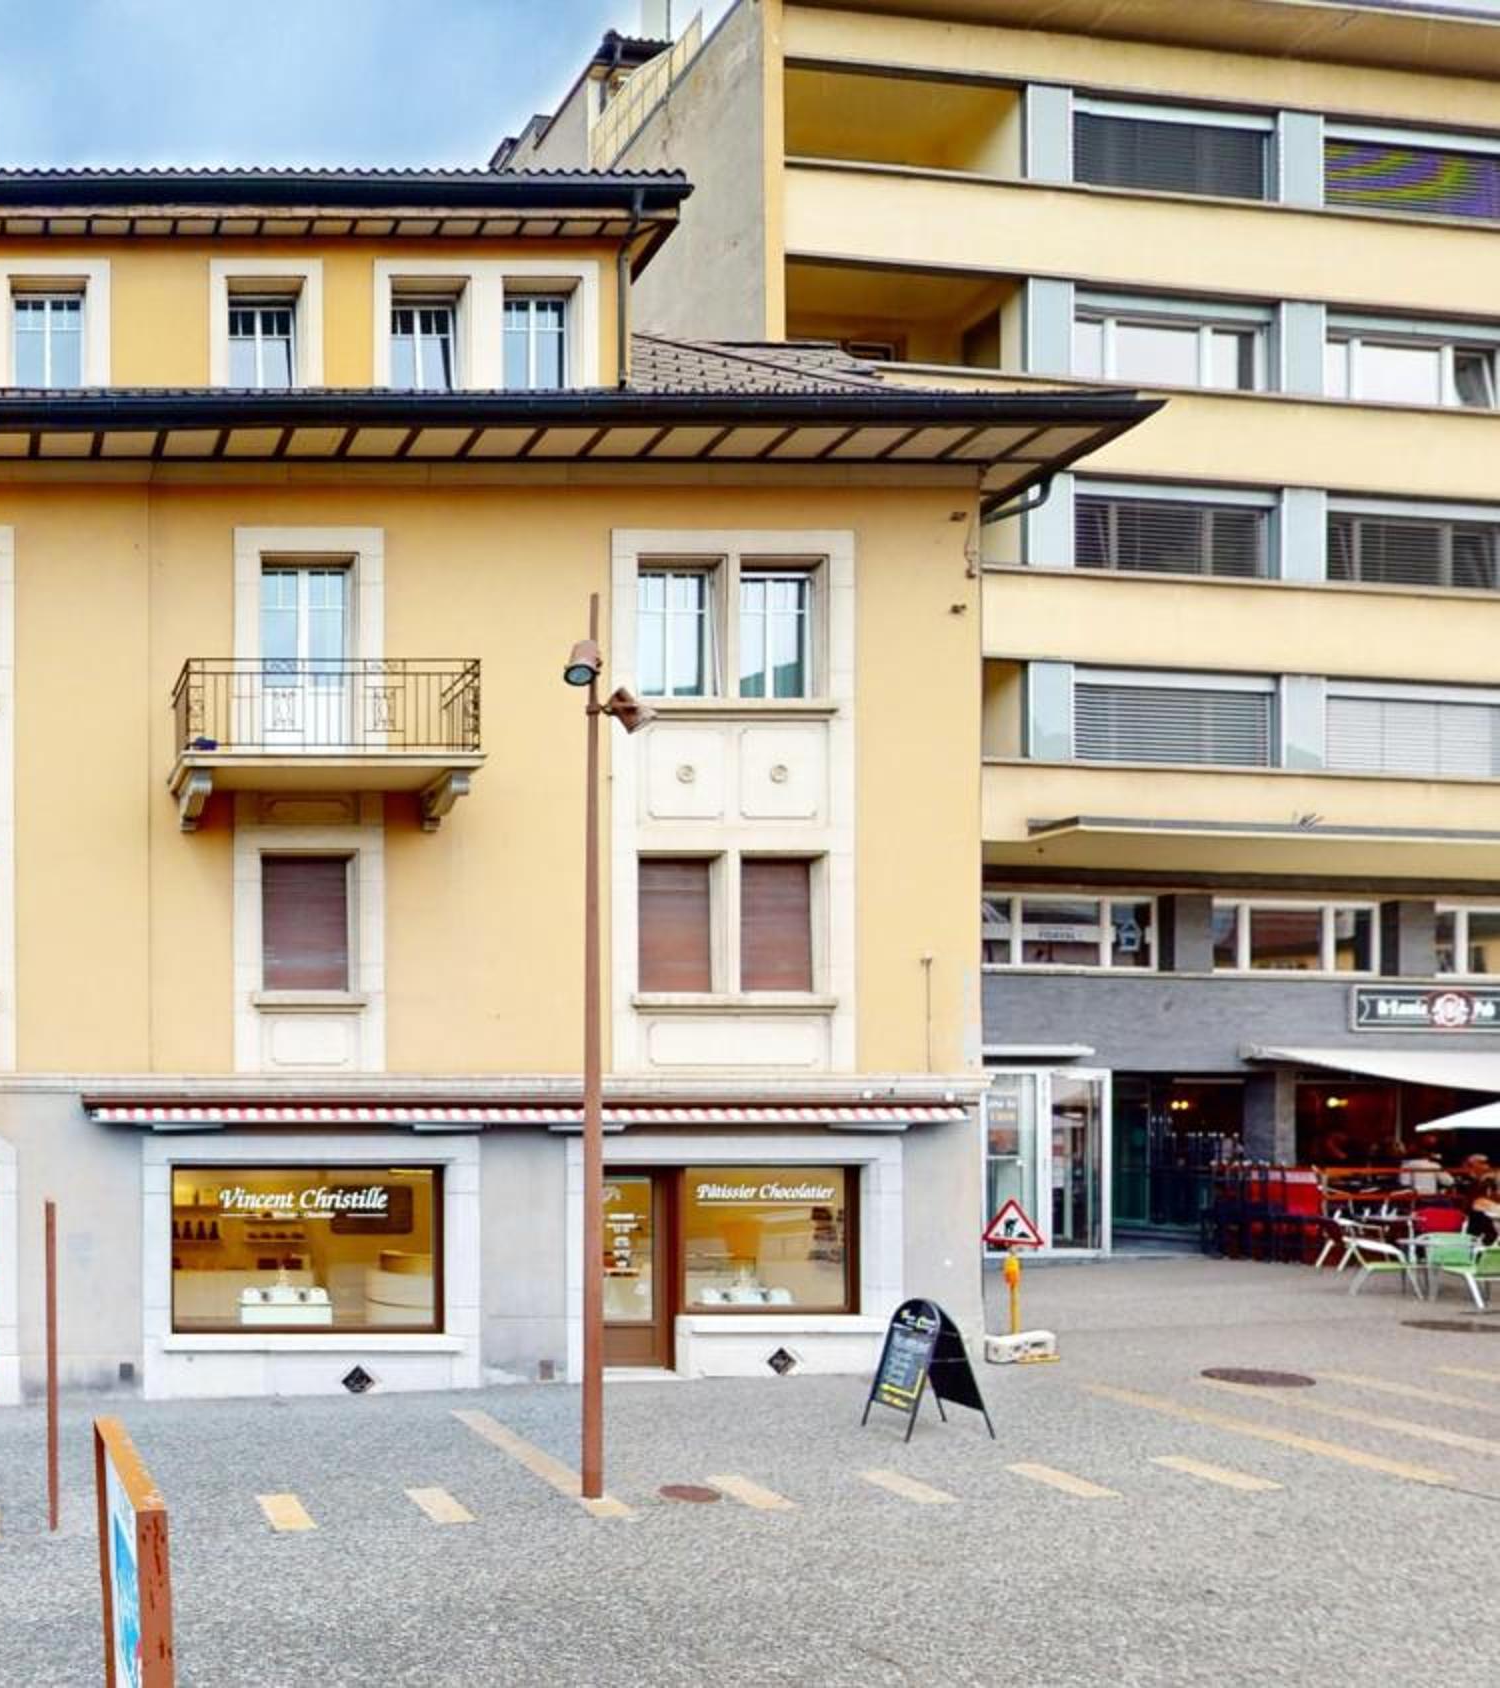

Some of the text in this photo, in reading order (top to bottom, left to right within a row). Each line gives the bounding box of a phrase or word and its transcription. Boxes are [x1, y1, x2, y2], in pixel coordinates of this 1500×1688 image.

[219, 1186, 388, 1209] Vincent Christille
[759, 1182, 836, 1199] Chocolatier
